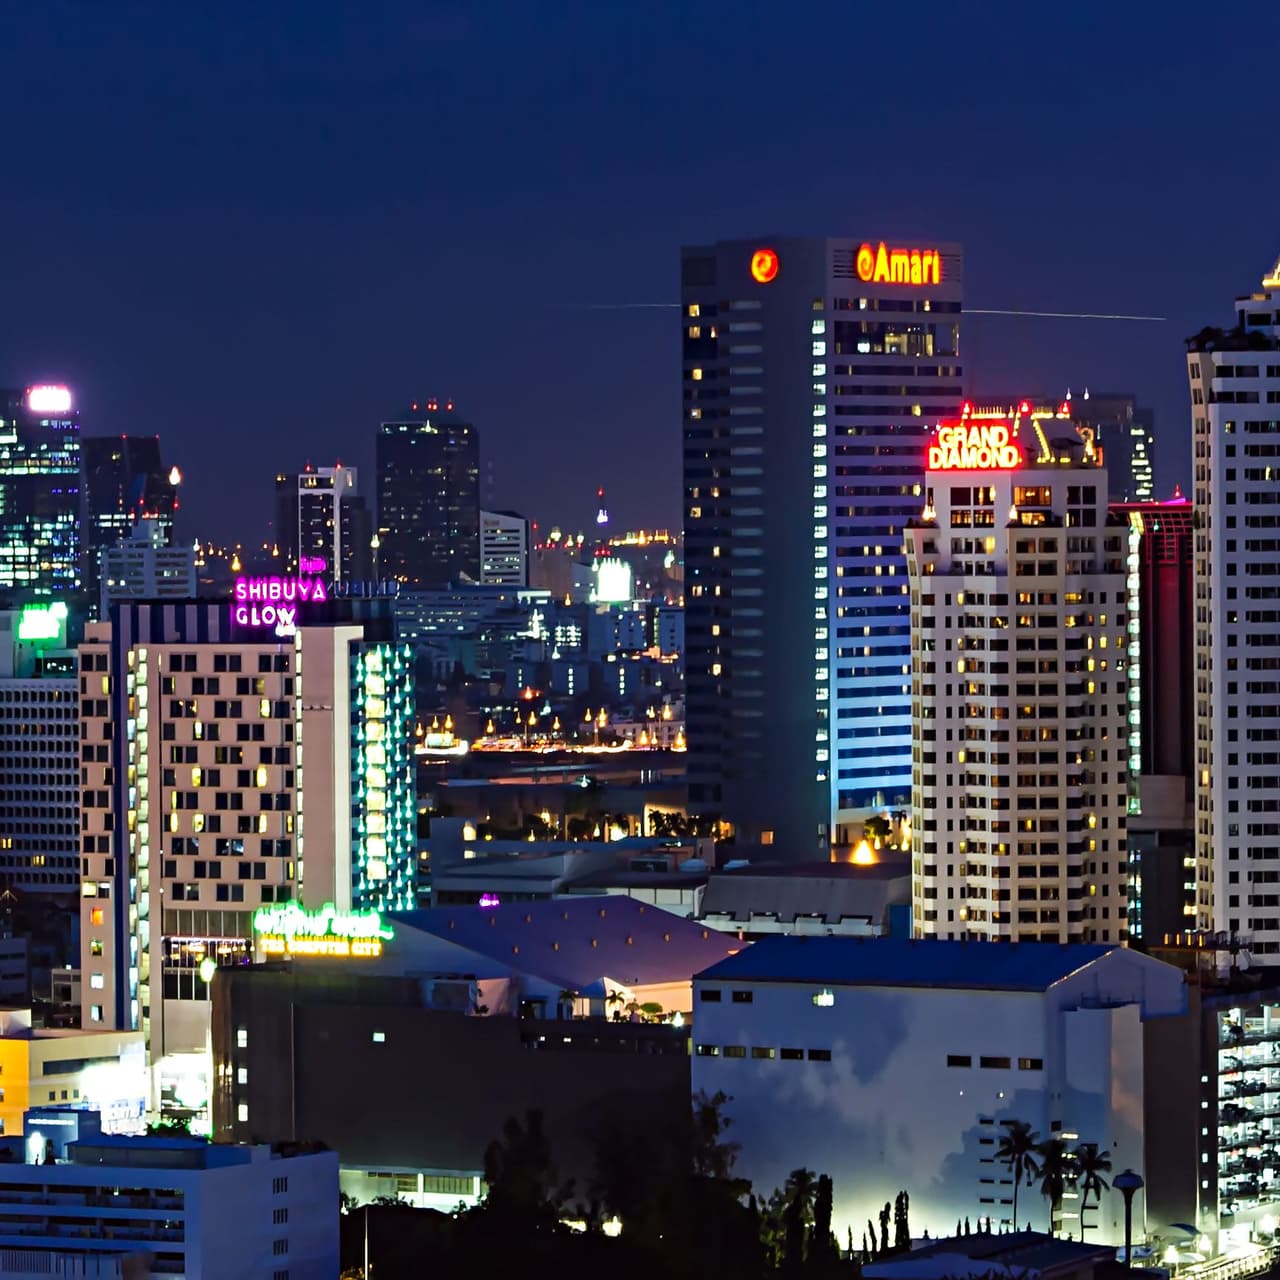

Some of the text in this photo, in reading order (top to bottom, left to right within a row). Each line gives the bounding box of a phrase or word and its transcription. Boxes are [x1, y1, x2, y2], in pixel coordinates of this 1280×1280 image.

[873, 243, 940, 285] Amari
[938, 426, 1009, 448] GRAND
[928, 446, 1019, 469] DIAMOND
[236, 580, 326, 600] SHIBUYA
[236, 605, 296, 626] GLOW
